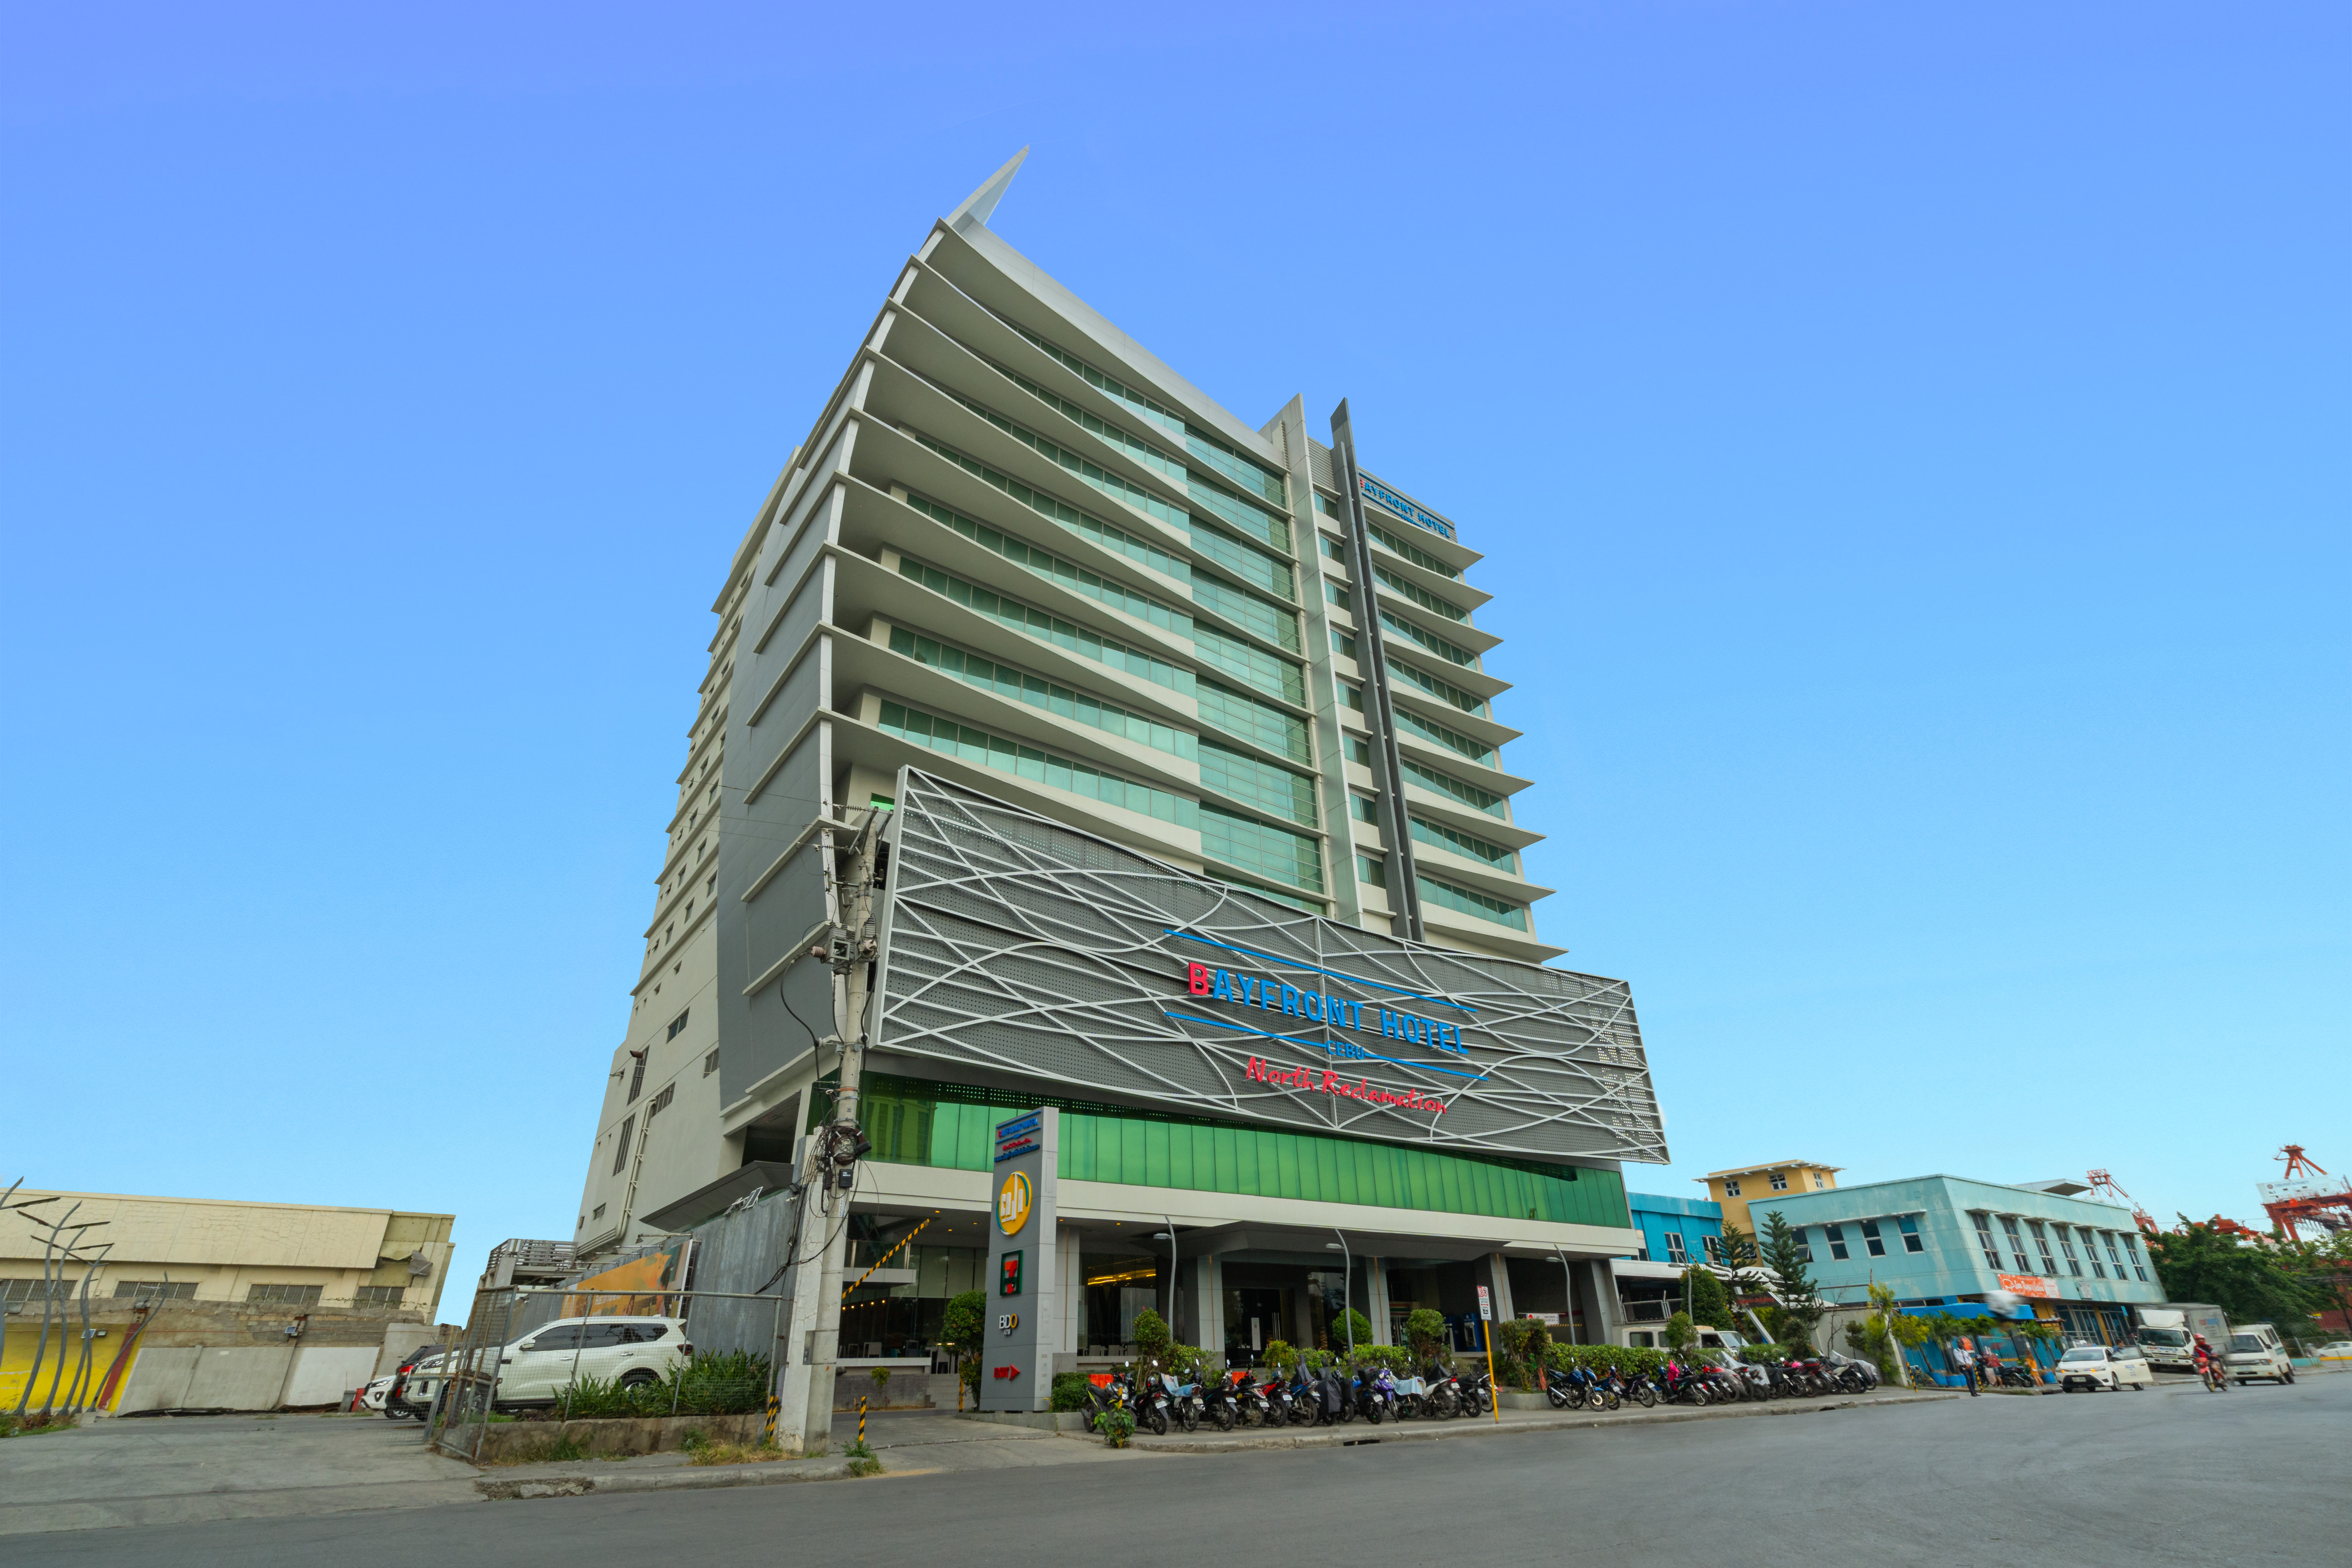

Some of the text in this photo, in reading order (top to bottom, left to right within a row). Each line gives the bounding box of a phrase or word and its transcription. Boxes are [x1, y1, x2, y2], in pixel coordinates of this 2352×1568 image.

[1359, 478, 1450, 538] BAYFRONT HOTEL
[1400, 514, 1414, 524] CEBU
[1189, 962, 1469, 1054] BAYFRONT HOTEL
[1326, 1040, 1365, 1060] CEBU
[1246, 1056, 1447, 1114] North Reclamation
[999, 1313, 1018, 1329] BDO
[994, 1367, 1009, 1378] EXIT
